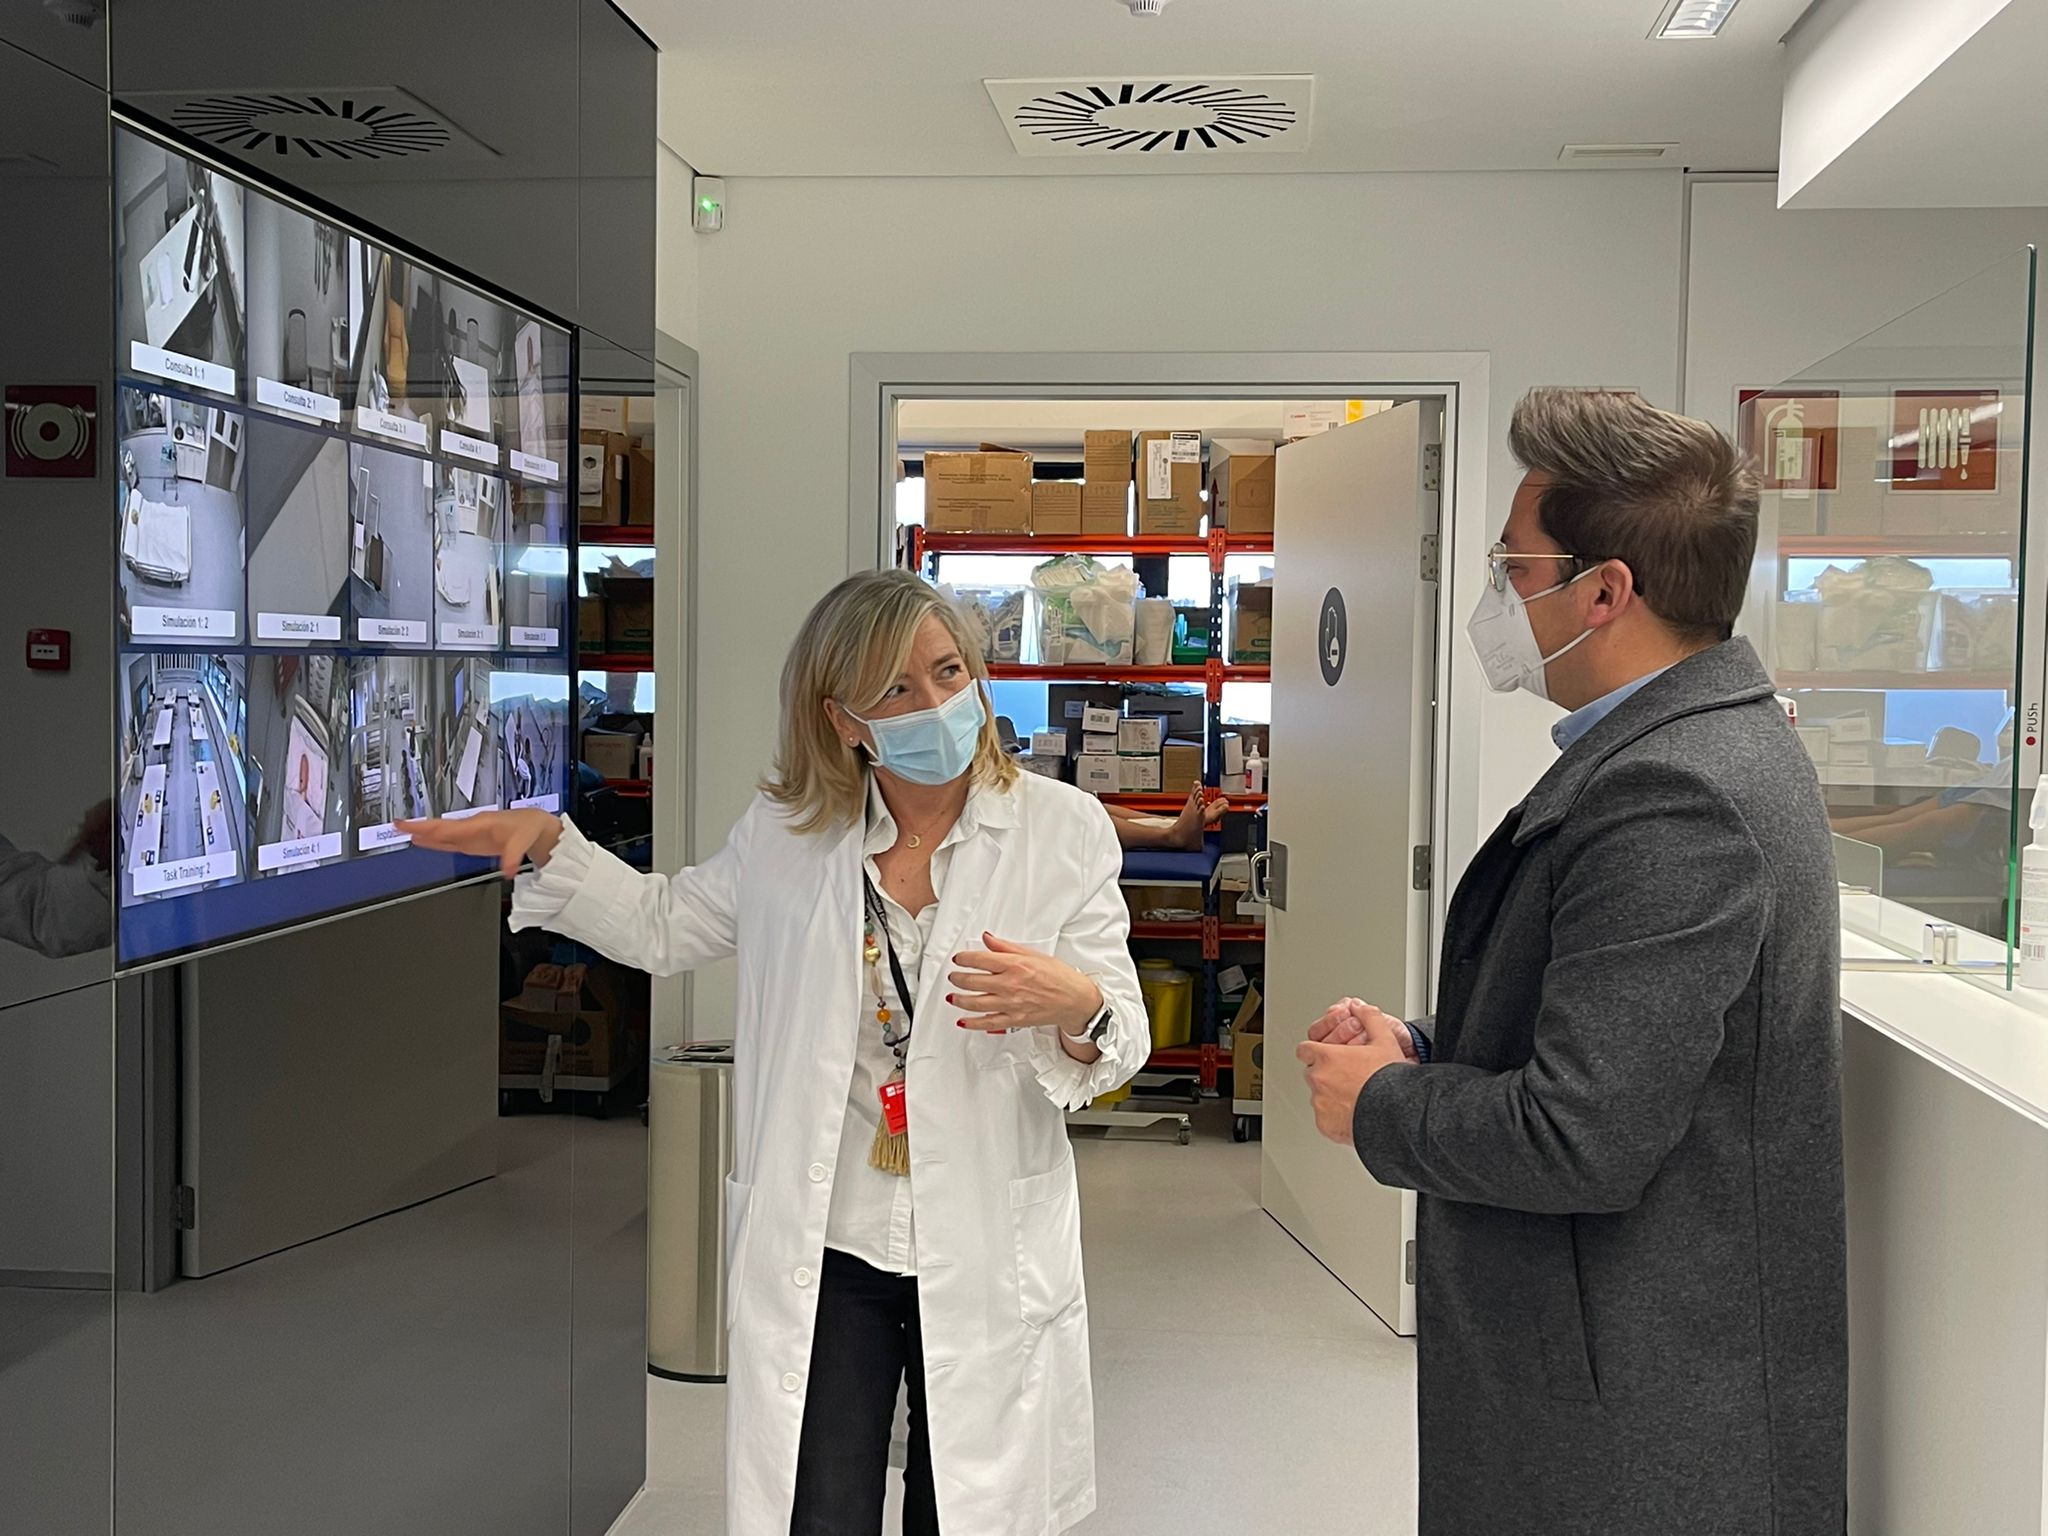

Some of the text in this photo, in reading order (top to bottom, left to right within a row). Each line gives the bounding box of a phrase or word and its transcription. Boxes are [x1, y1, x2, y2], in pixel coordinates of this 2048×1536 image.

[165, 357, 193, 377] Consulta
[284, 390, 306, 408] Consulta
[162, 615, 196, 628] Simulación
[282, 620, 309, 633] Simulación
[282, 845, 310, 859] Simulación
[163, 868, 178, 881] Task
